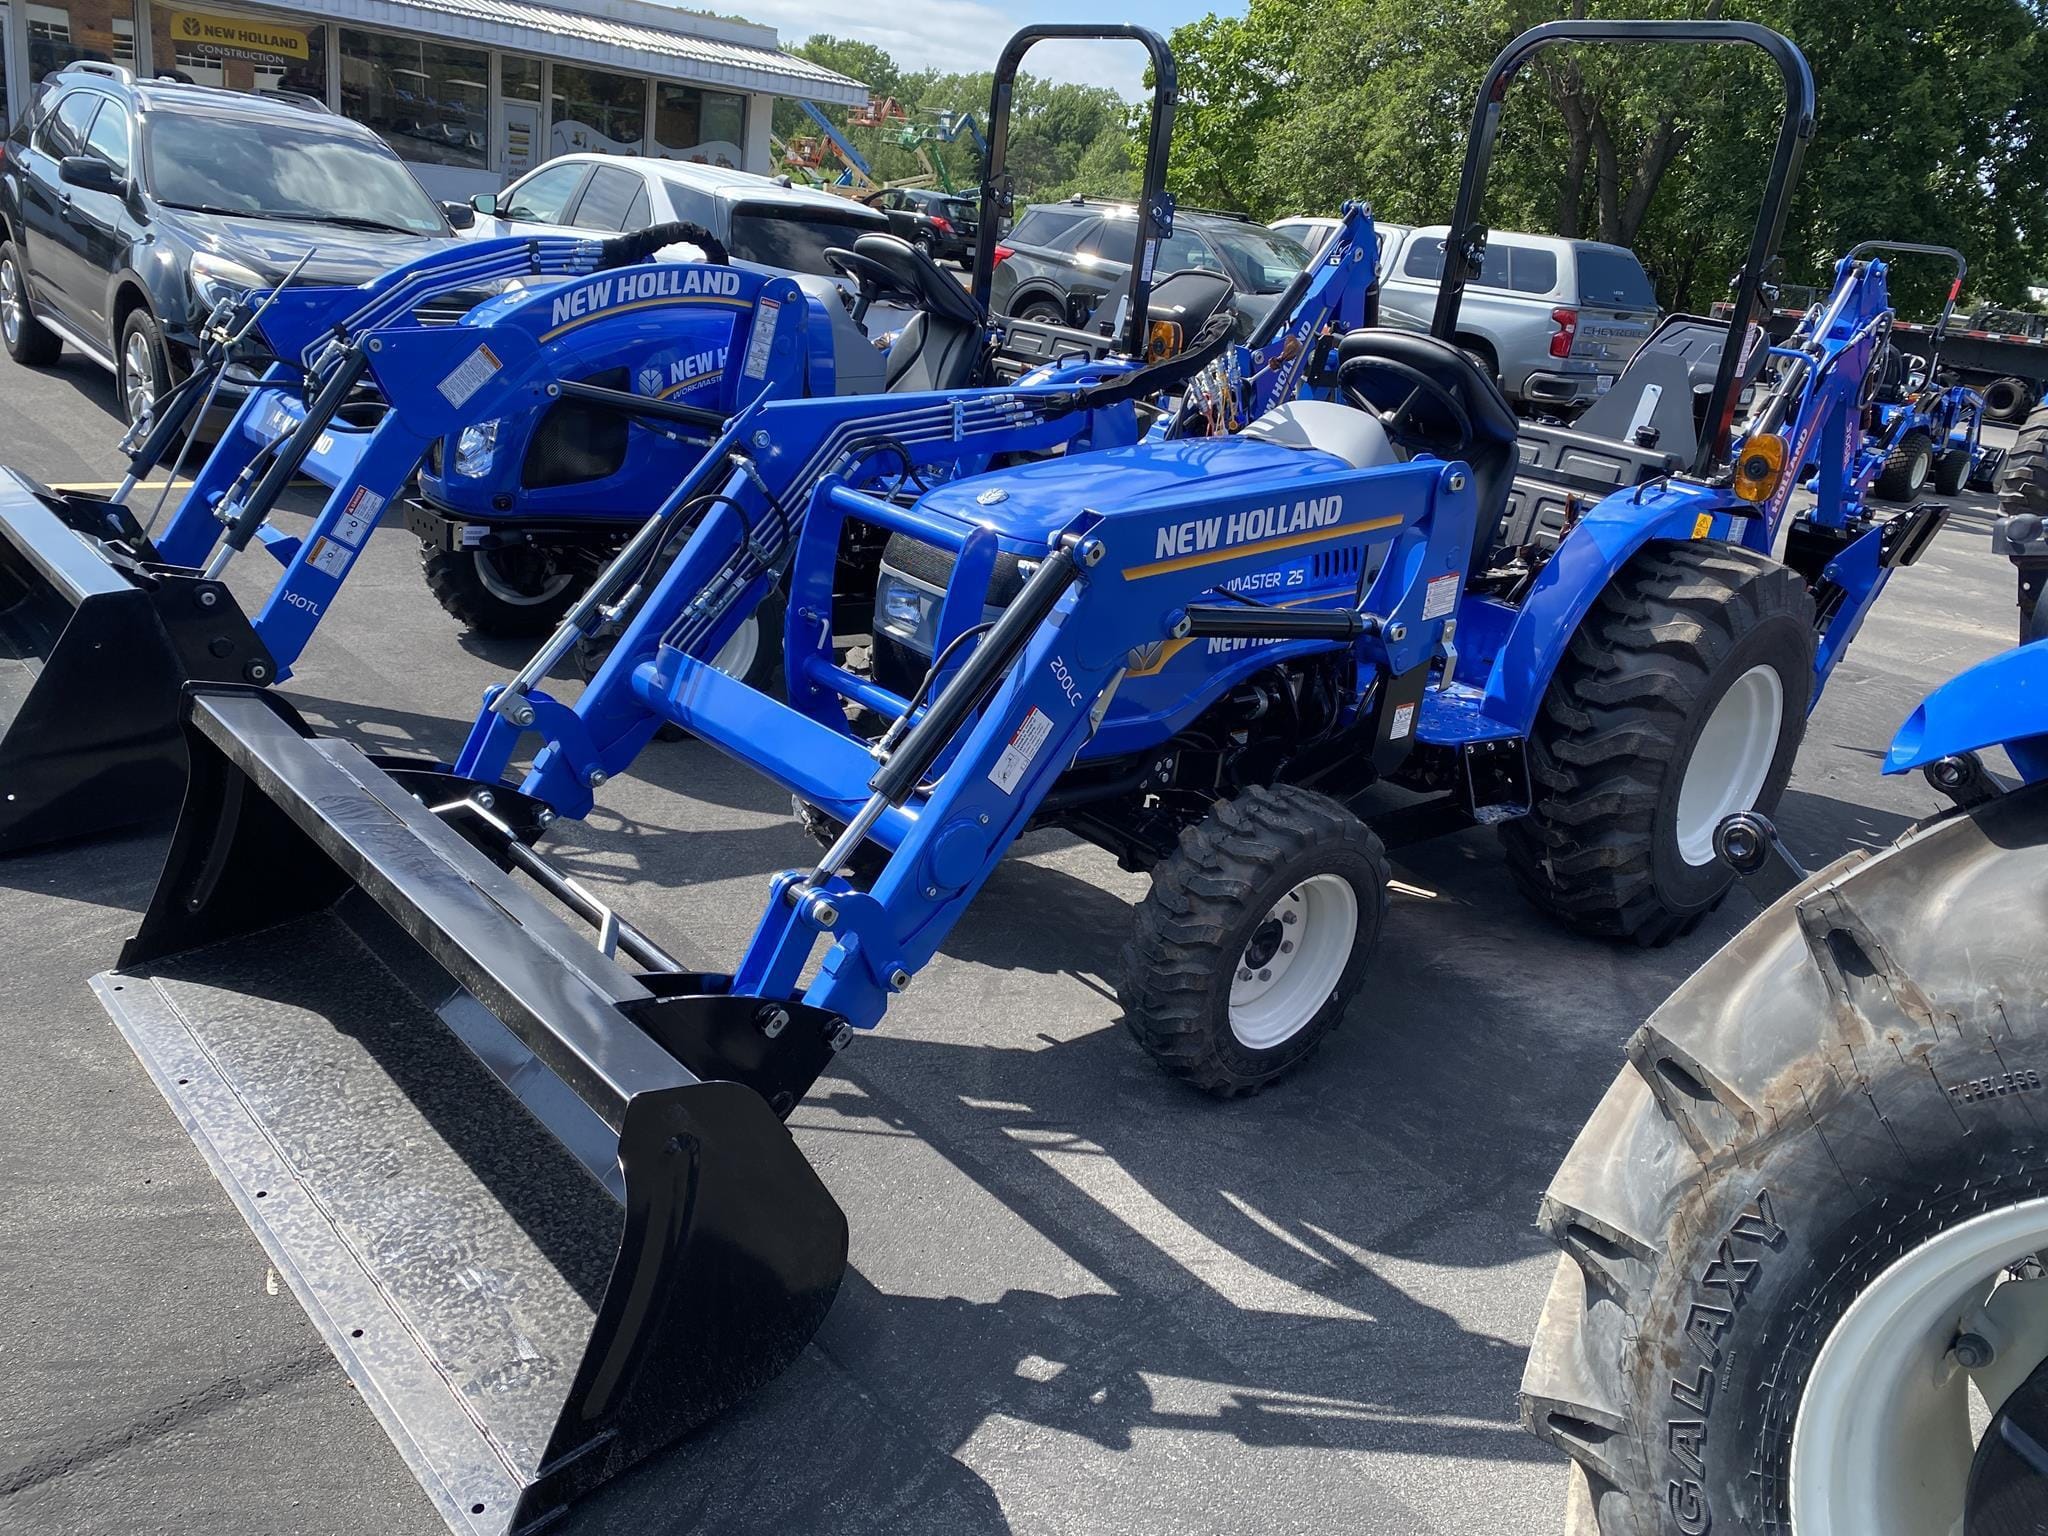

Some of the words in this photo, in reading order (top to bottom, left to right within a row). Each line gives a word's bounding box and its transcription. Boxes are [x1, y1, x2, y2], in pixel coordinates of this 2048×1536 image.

[197, 43, 284, 64] CONSTRUCTION
[204, 24, 235, 39] NEW
[238, 30, 298, 49] HOLLAND
[551, 279, 612, 327] NEW
[616, 270, 740, 302] HOLLAND
[670, 350, 713, 385] NEW
[1771, 428, 1808, 513] HOLLAND
[1155, 516, 1222, 559] NEW
[1225, 495, 1343, 545] HOLLAND
[1286, 569, 1304, 586] 25
[283, 589, 320, 617] 140TL
[1049, 655, 1083, 708] 200LC
[1948, 1069, 2040, 1106] TUBELESS
[1669, 1187, 1786, 1536] GALAXY
